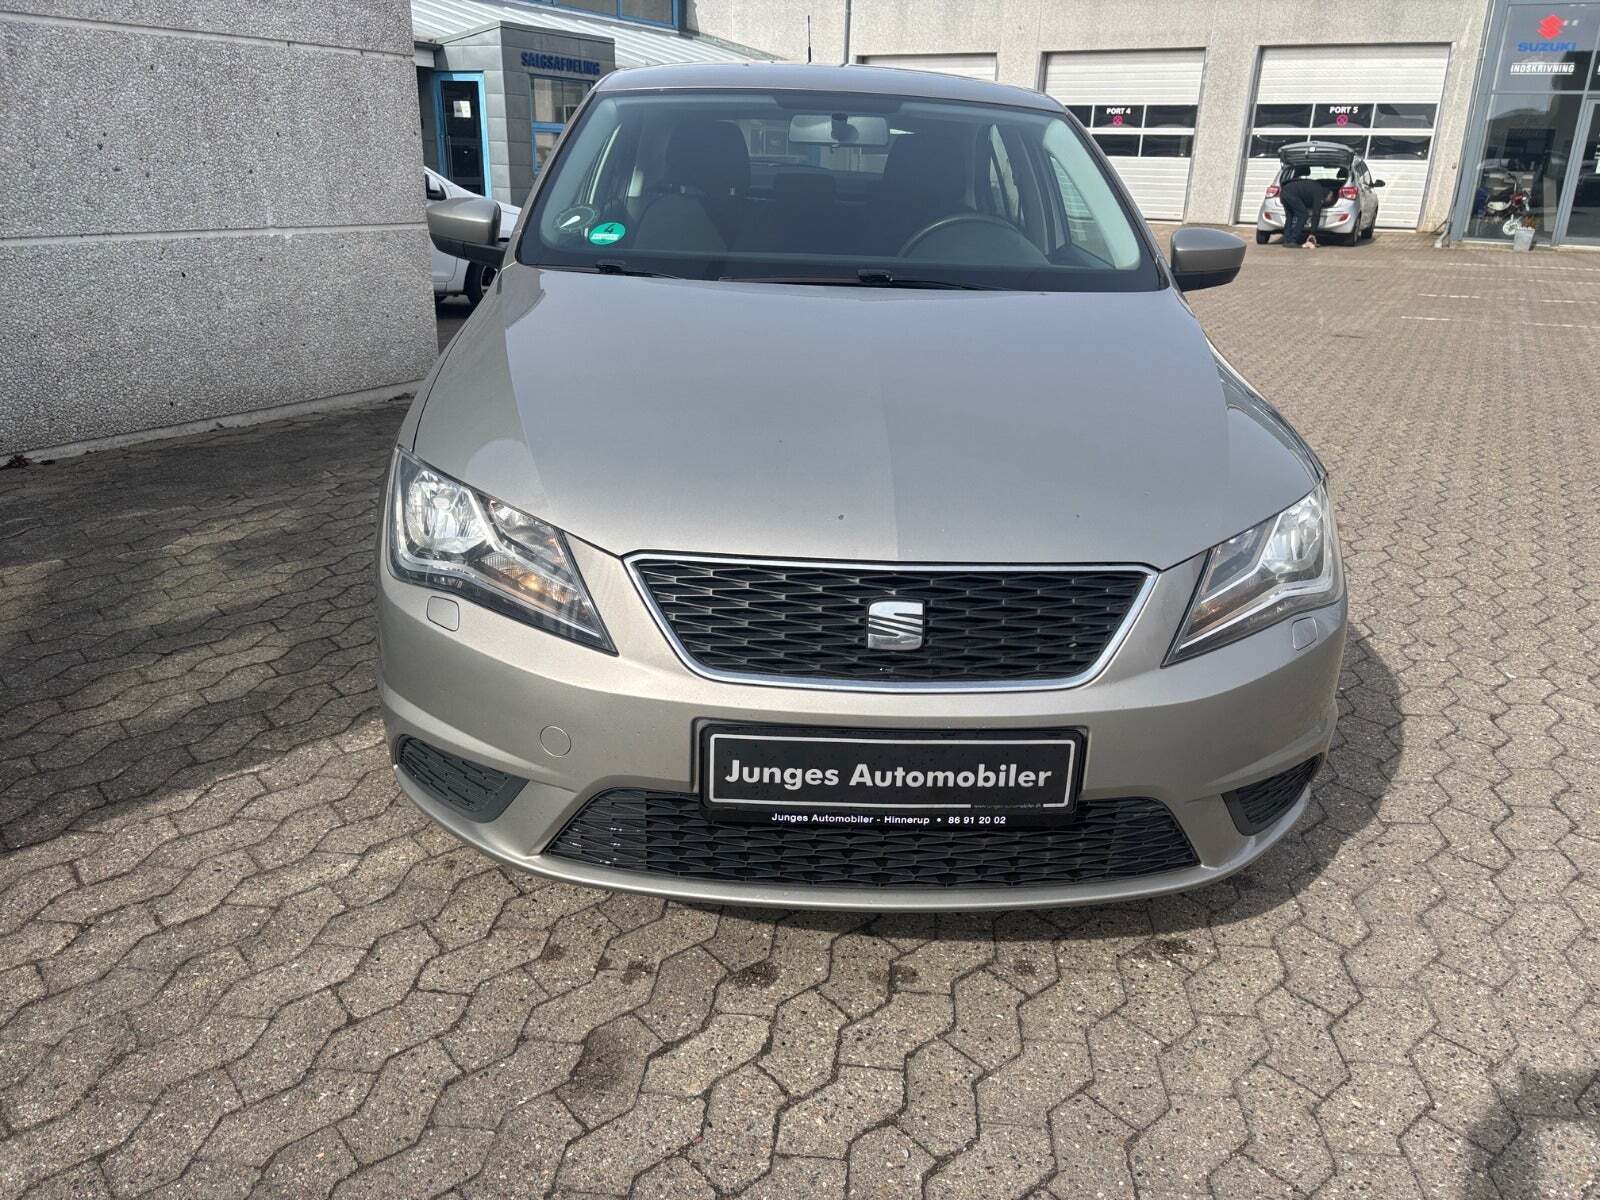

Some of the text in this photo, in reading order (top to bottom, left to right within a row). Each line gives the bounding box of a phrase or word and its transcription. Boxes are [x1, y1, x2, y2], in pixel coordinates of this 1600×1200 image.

[1518, 42, 1576, 52] SUZUKI
[1510, 64, 1575, 73] INDSKRIVNING
[1329, 106, 1358, 114] PORT 5
[725, 759, 1052, 790] Junges Automobiler
[771, 813, 808, 822] Junges
[811, 814, 874, 823] Automobiler
[884, 816, 930, 826] Hinnerup
[948, 816, 960, 824] 86
[963, 816, 974, 824] 91
[978, 816, 991, 824] 20
[993, 816, 1006, 824] 02
